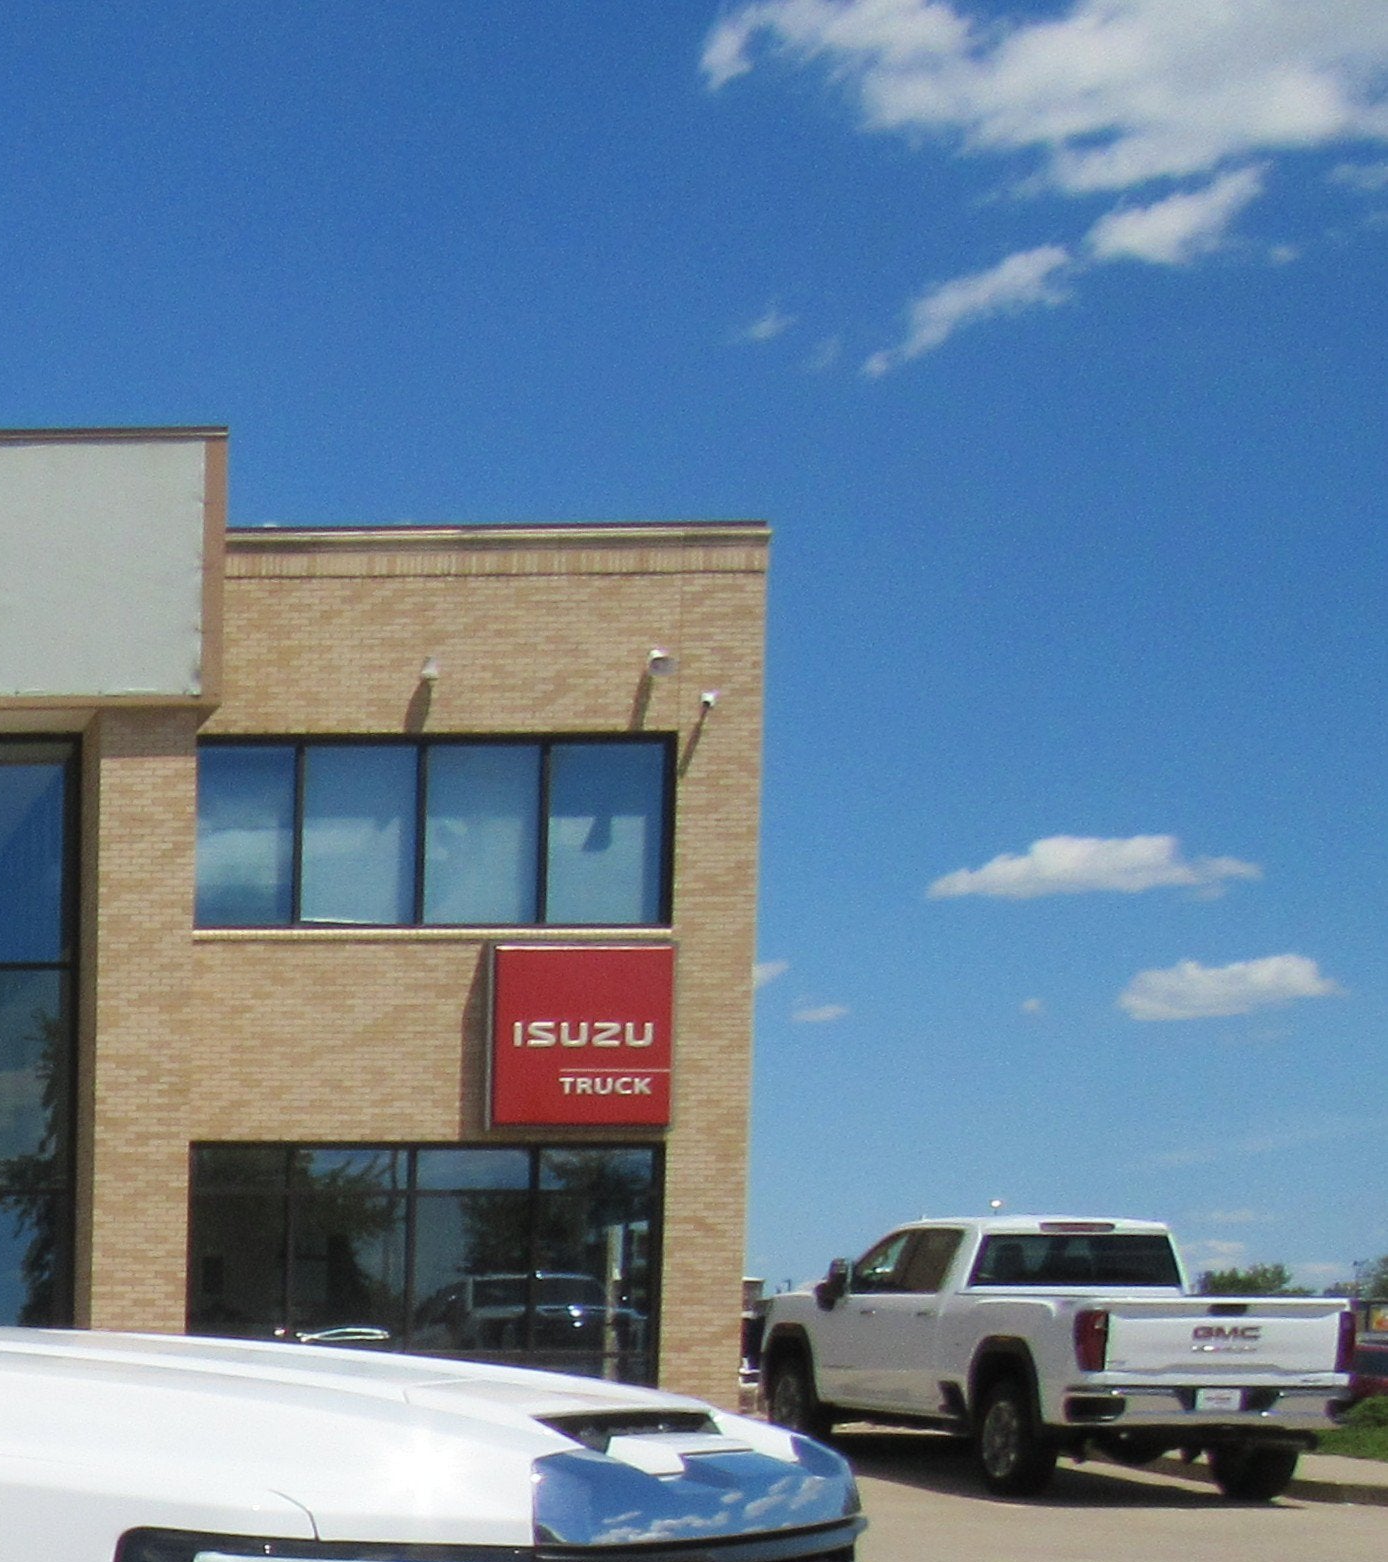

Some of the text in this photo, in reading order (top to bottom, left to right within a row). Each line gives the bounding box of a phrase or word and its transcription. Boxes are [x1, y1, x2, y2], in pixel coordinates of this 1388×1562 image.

[513, 1021, 654, 1048] ISUZU
[558, 1077, 652, 1095] TRUCK
[1192, 1325, 1261, 1340] GMC
